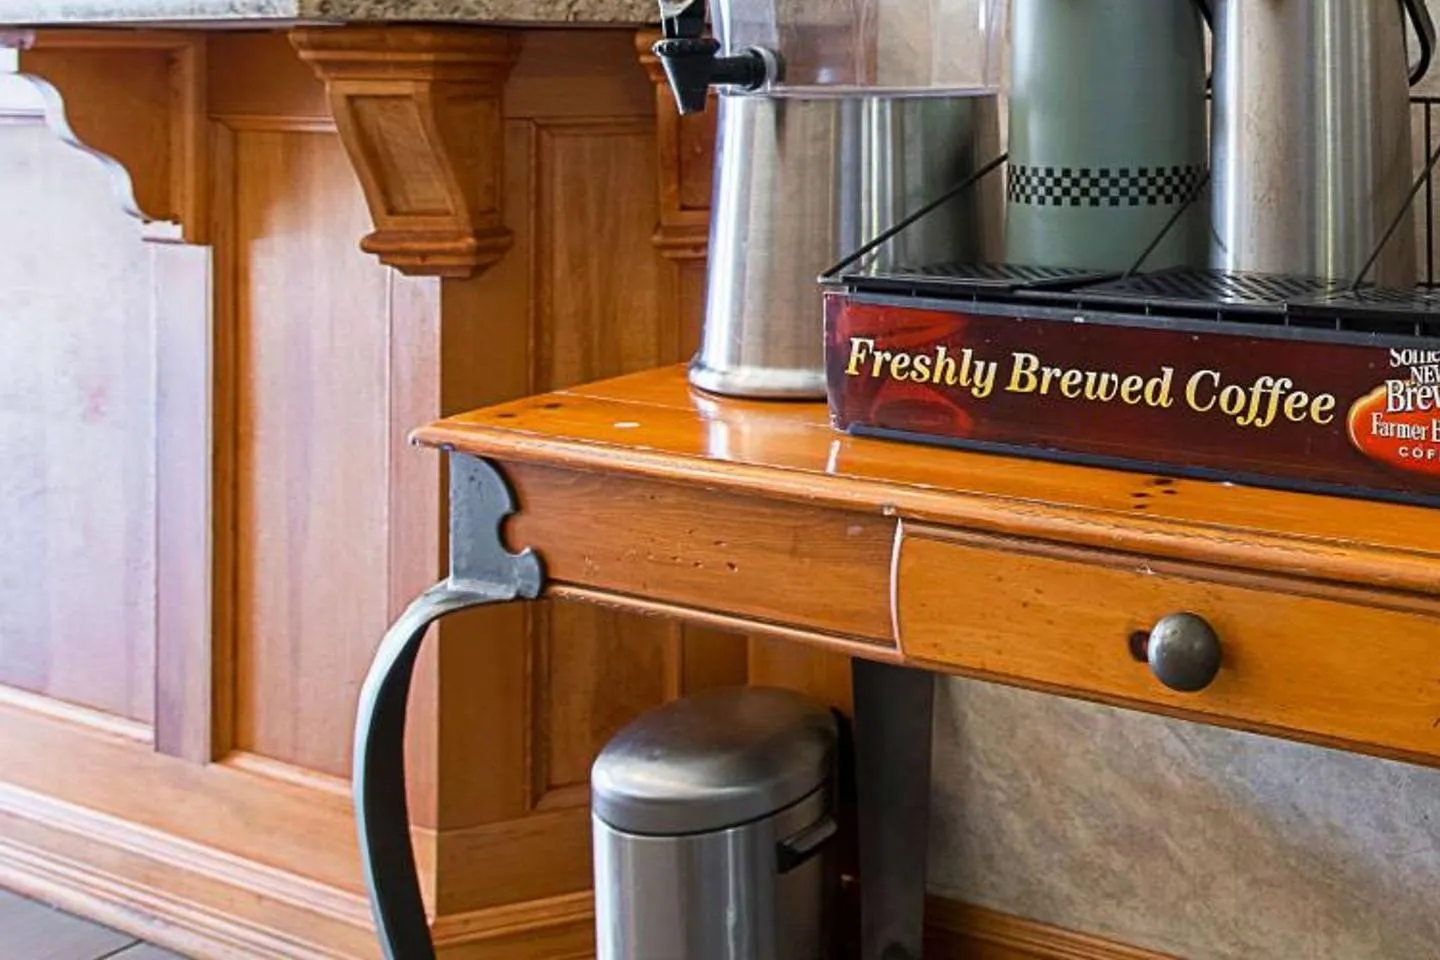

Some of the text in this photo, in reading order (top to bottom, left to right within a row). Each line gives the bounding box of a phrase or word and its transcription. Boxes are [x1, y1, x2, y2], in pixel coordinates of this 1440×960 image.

[844, 336, 1337, 428] Freshly Brewed Coffee
[1371, 411, 1428, 441] Farmer
